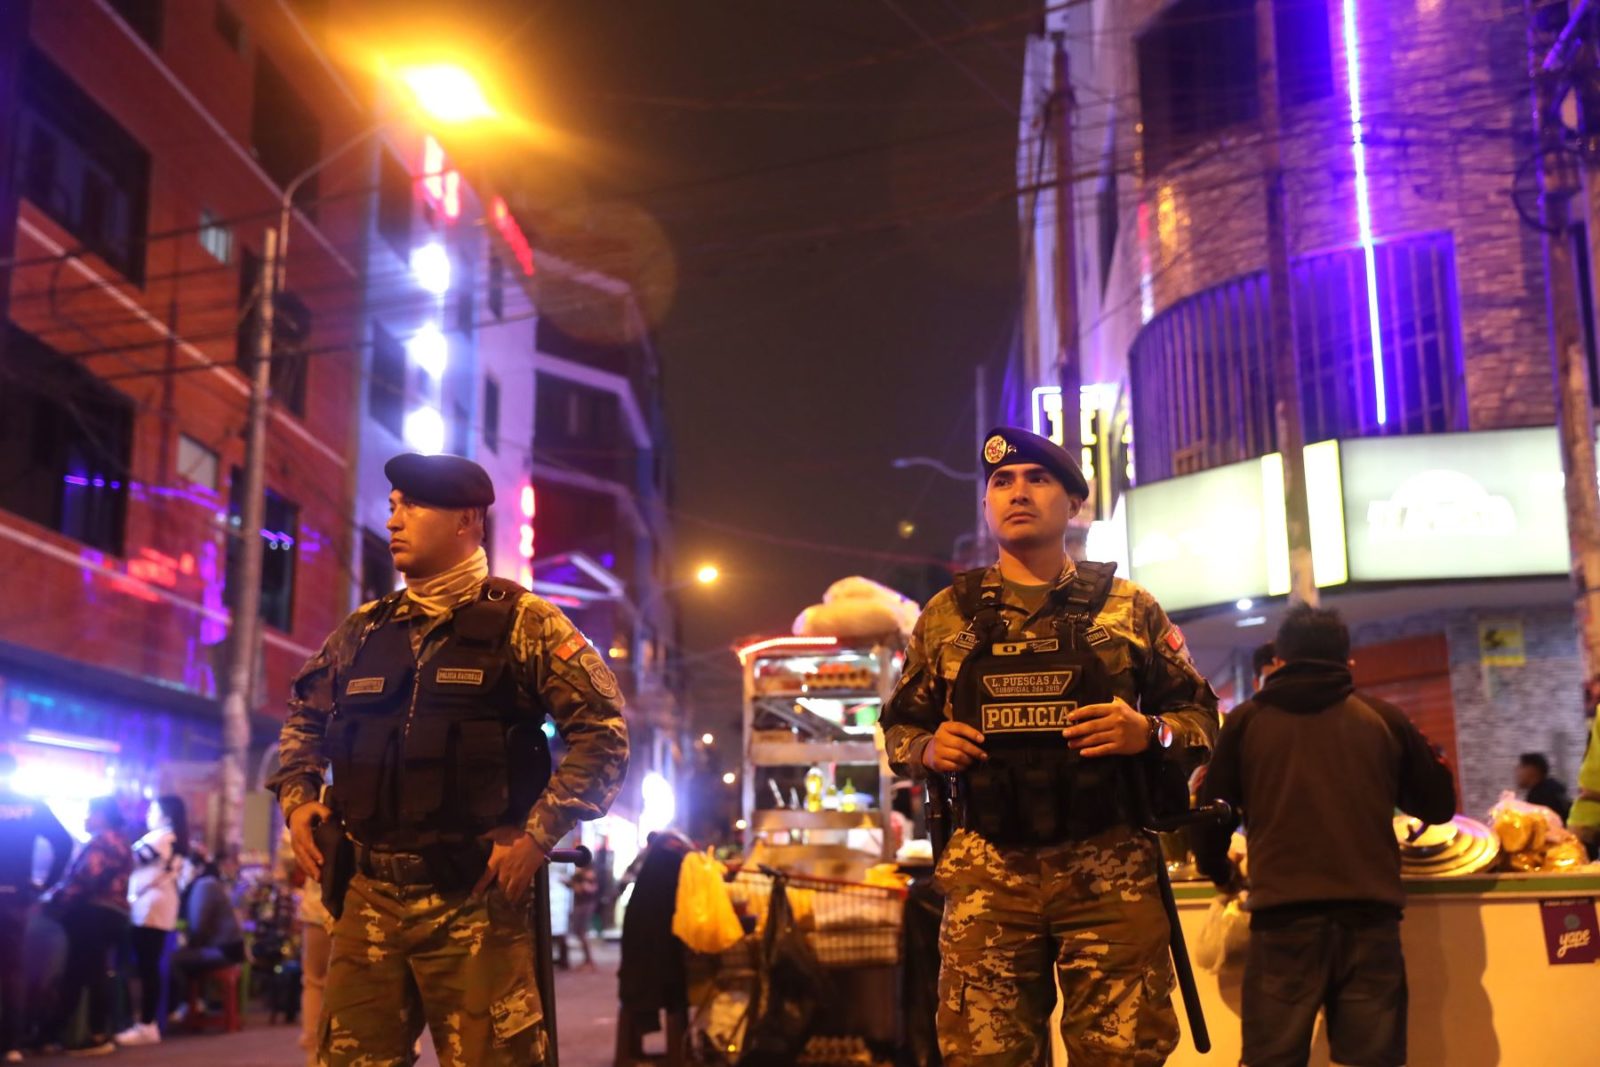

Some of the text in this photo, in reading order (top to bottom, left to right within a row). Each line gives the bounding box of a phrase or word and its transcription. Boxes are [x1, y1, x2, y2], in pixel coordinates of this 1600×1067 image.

[991, 675, 1062, 687] L. PUESCAS A.
[986, 707, 1073, 728] POLICIA
[1556, 929, 1591, 958] yape
